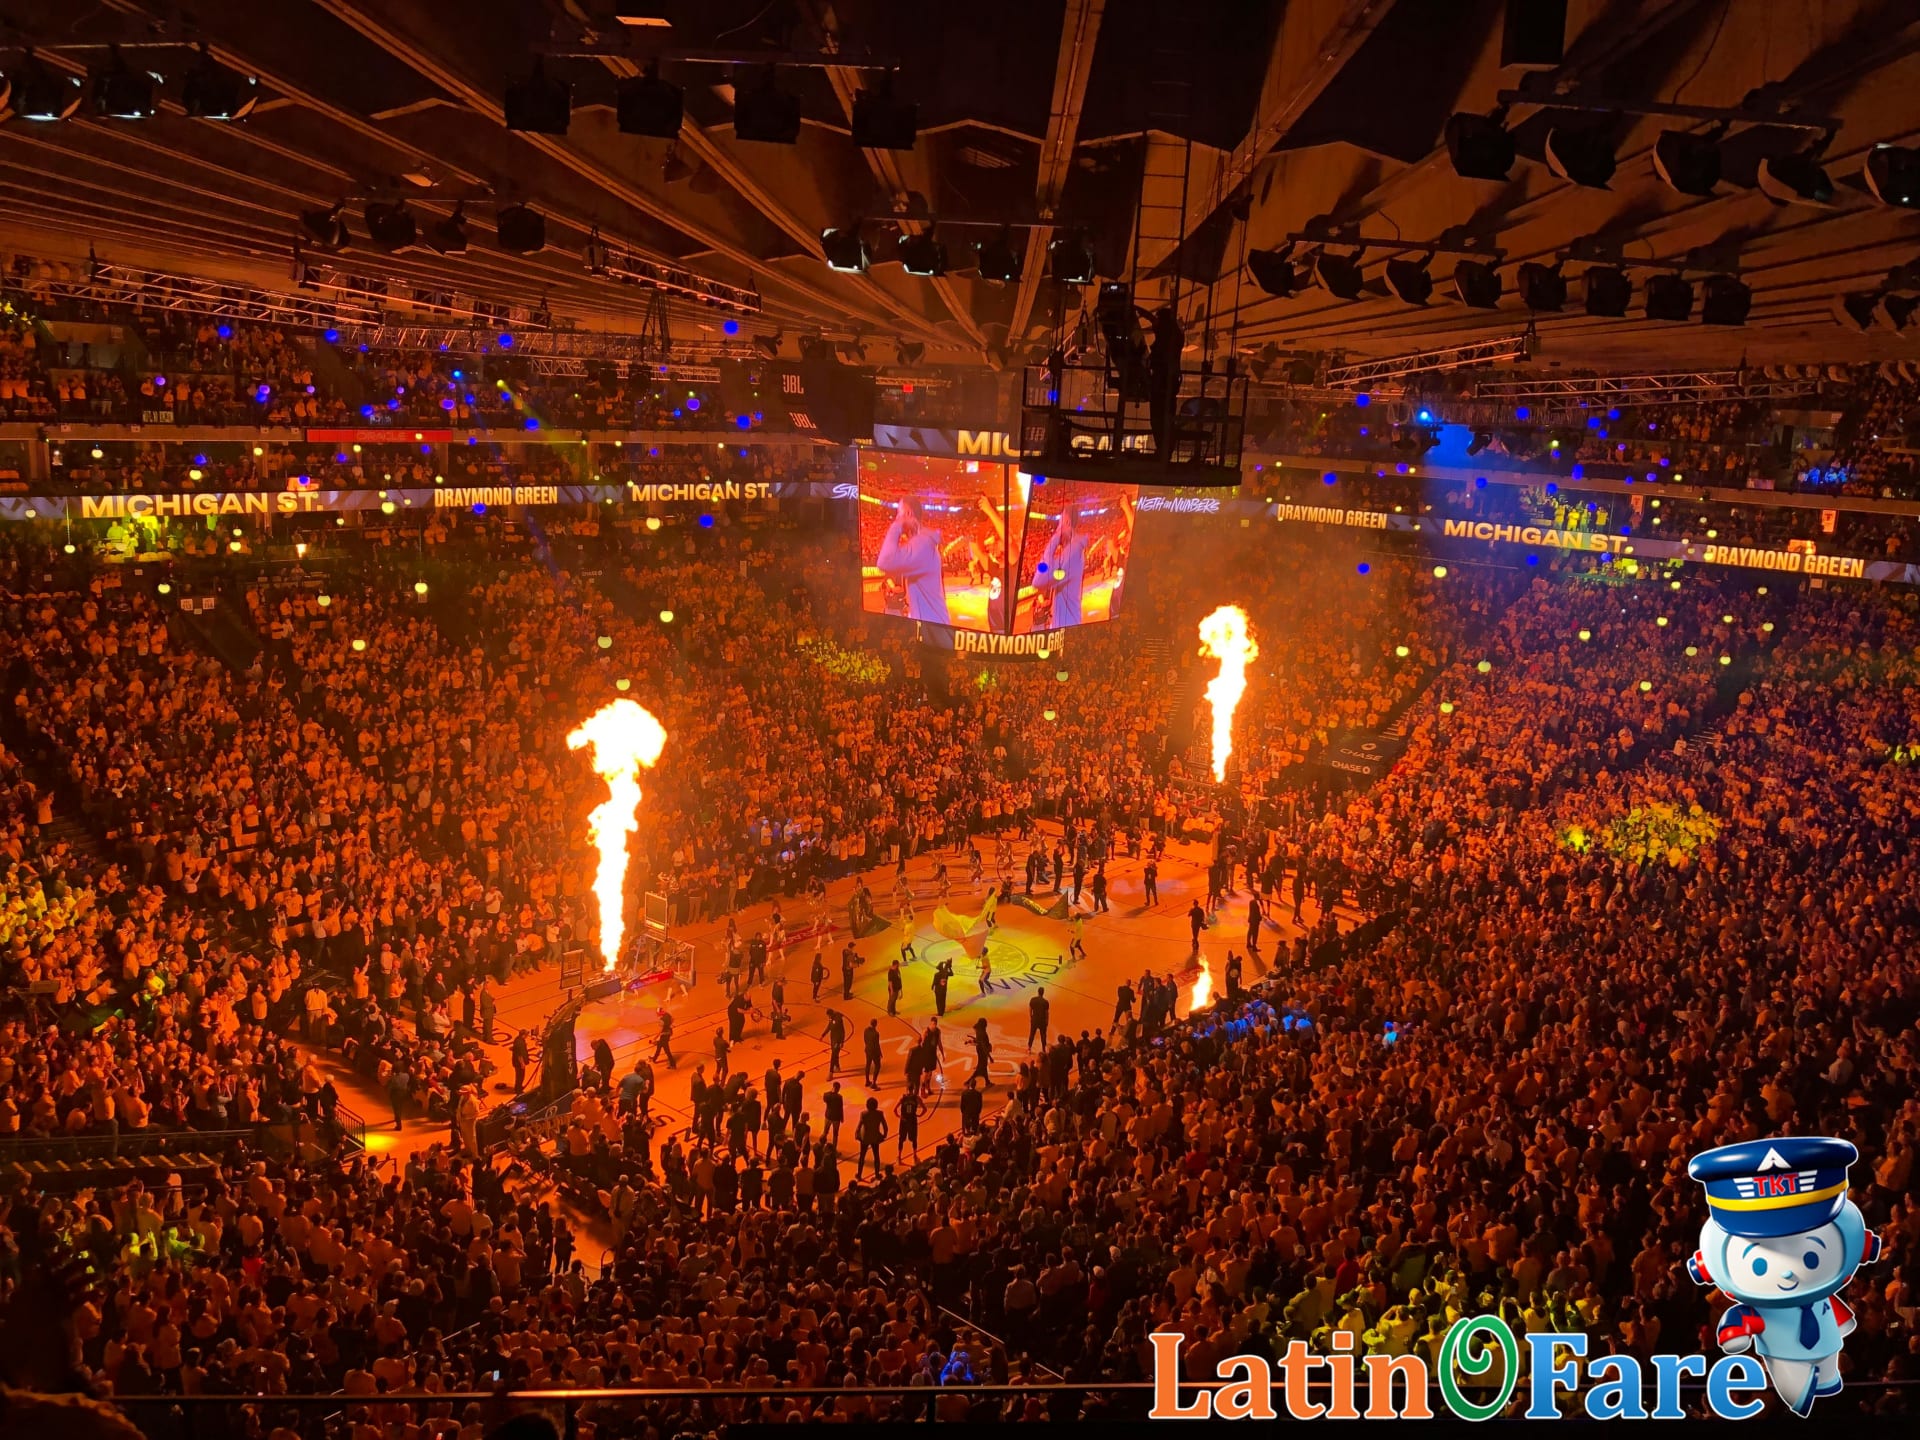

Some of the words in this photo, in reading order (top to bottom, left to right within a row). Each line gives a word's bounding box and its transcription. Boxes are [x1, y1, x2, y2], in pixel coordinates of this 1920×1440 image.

[782, 374, 804, 394] JBL
[356, 431, 408, 442] ORACLE
[434, 487, 512, 508] DRAYMOND
[515, 486, 558, 505] GREEN
[631, 483, 740, 502] MICHIGAN
[744, 482, 773, 499] ST.
[81, 491, 268, 518] MICHIGAN
[277, 491, 324, 513] ST.
[1277, 503, 1344, 525] DRAYMOND
[1345, 510, 1387, 529] GREEN
[1444, 519, 1583, 550] MICHIGAN
[1705, 544, 1801, 572] DRAYMOND
[1804, 554, 1865, 578] GREEN
[954, 630, 1045, 655] DRAYMOND
[1339, 748, 1383, 762] CHASE
[1331, 760, 1362, 773] CHASE
